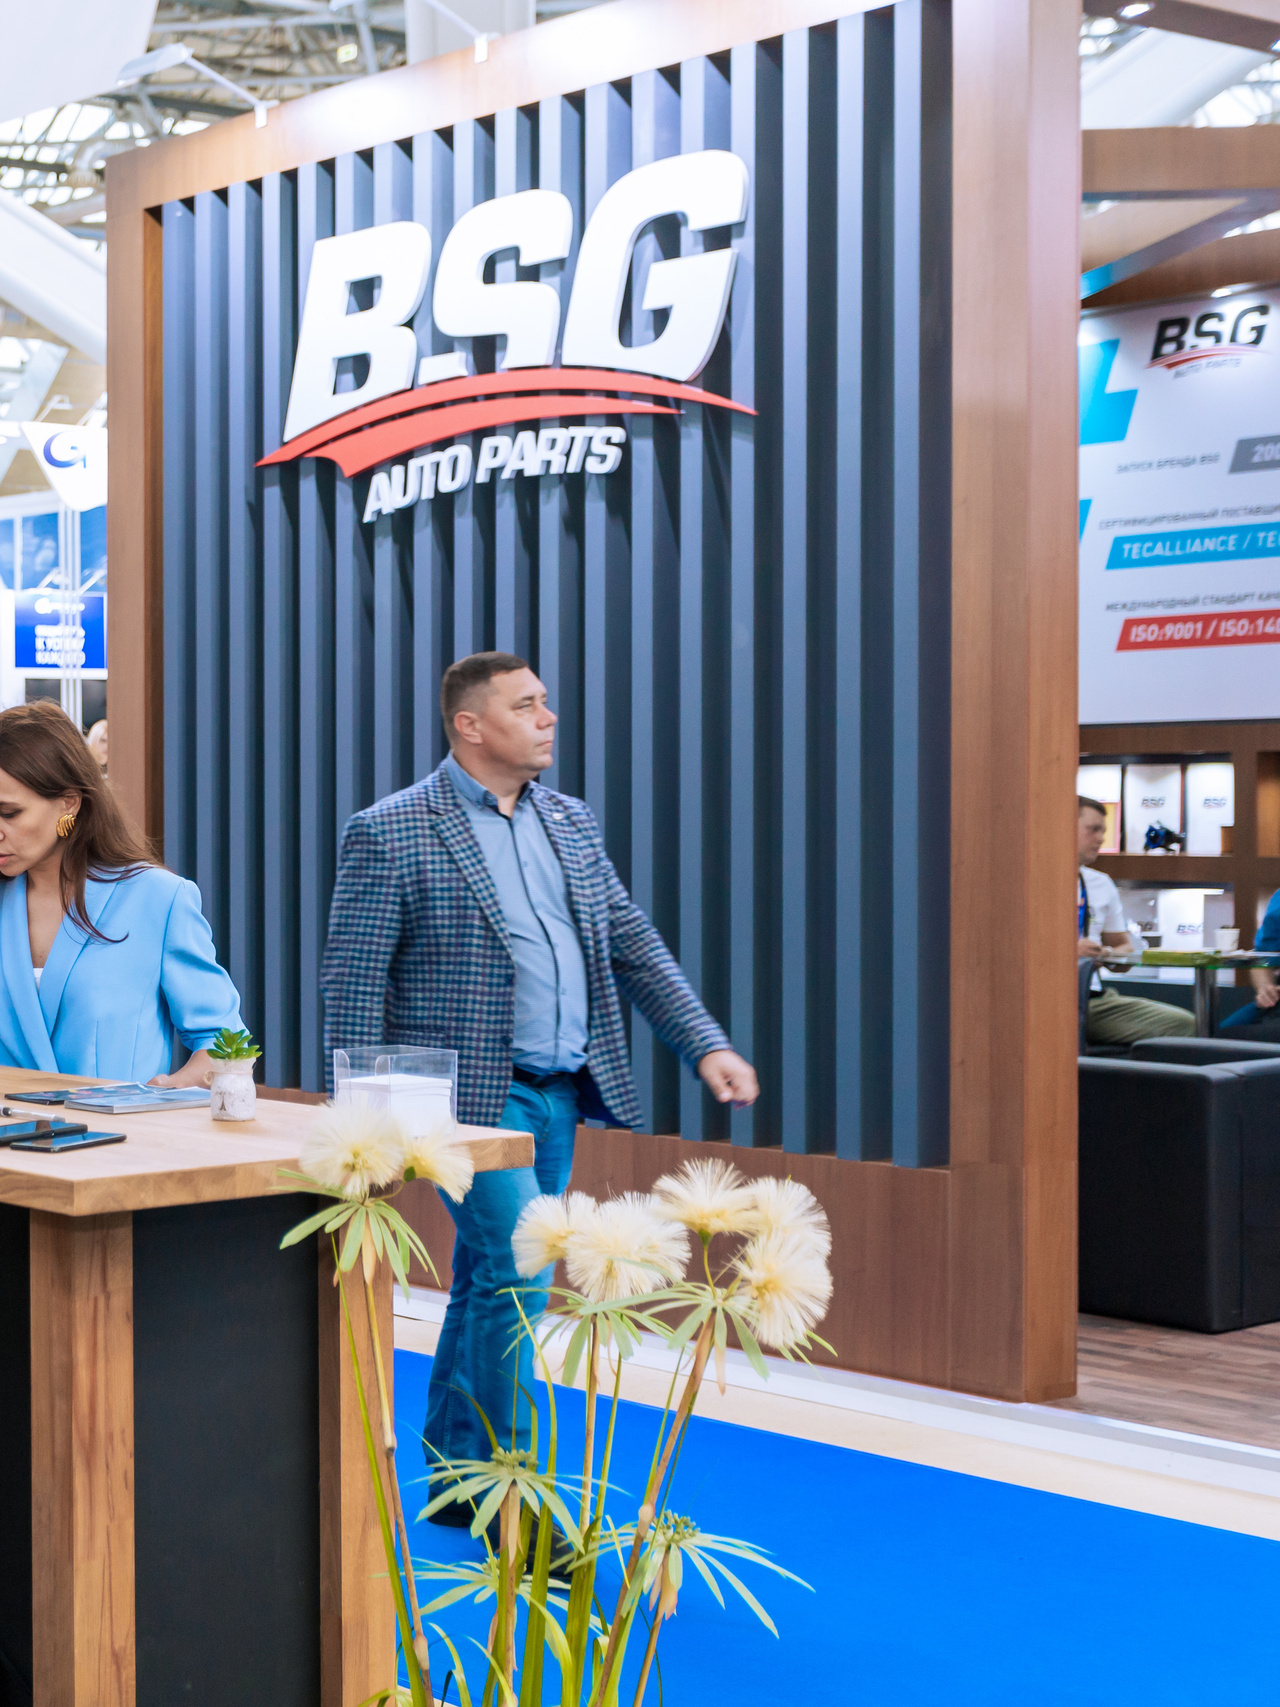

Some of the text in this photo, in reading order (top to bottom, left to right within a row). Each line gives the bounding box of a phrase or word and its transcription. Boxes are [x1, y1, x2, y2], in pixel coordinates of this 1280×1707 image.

[283, 149, 750, 443] BSG
[1150, 304, 1270, 361] BSG
[363, 425, 626, 523] AUTO PARTS
[1122, 534, 1238, 560] TECALLIANCE
[1257, 529, 1280, 549] TE
[1129, 620, 1203, 643] ISO:9001
